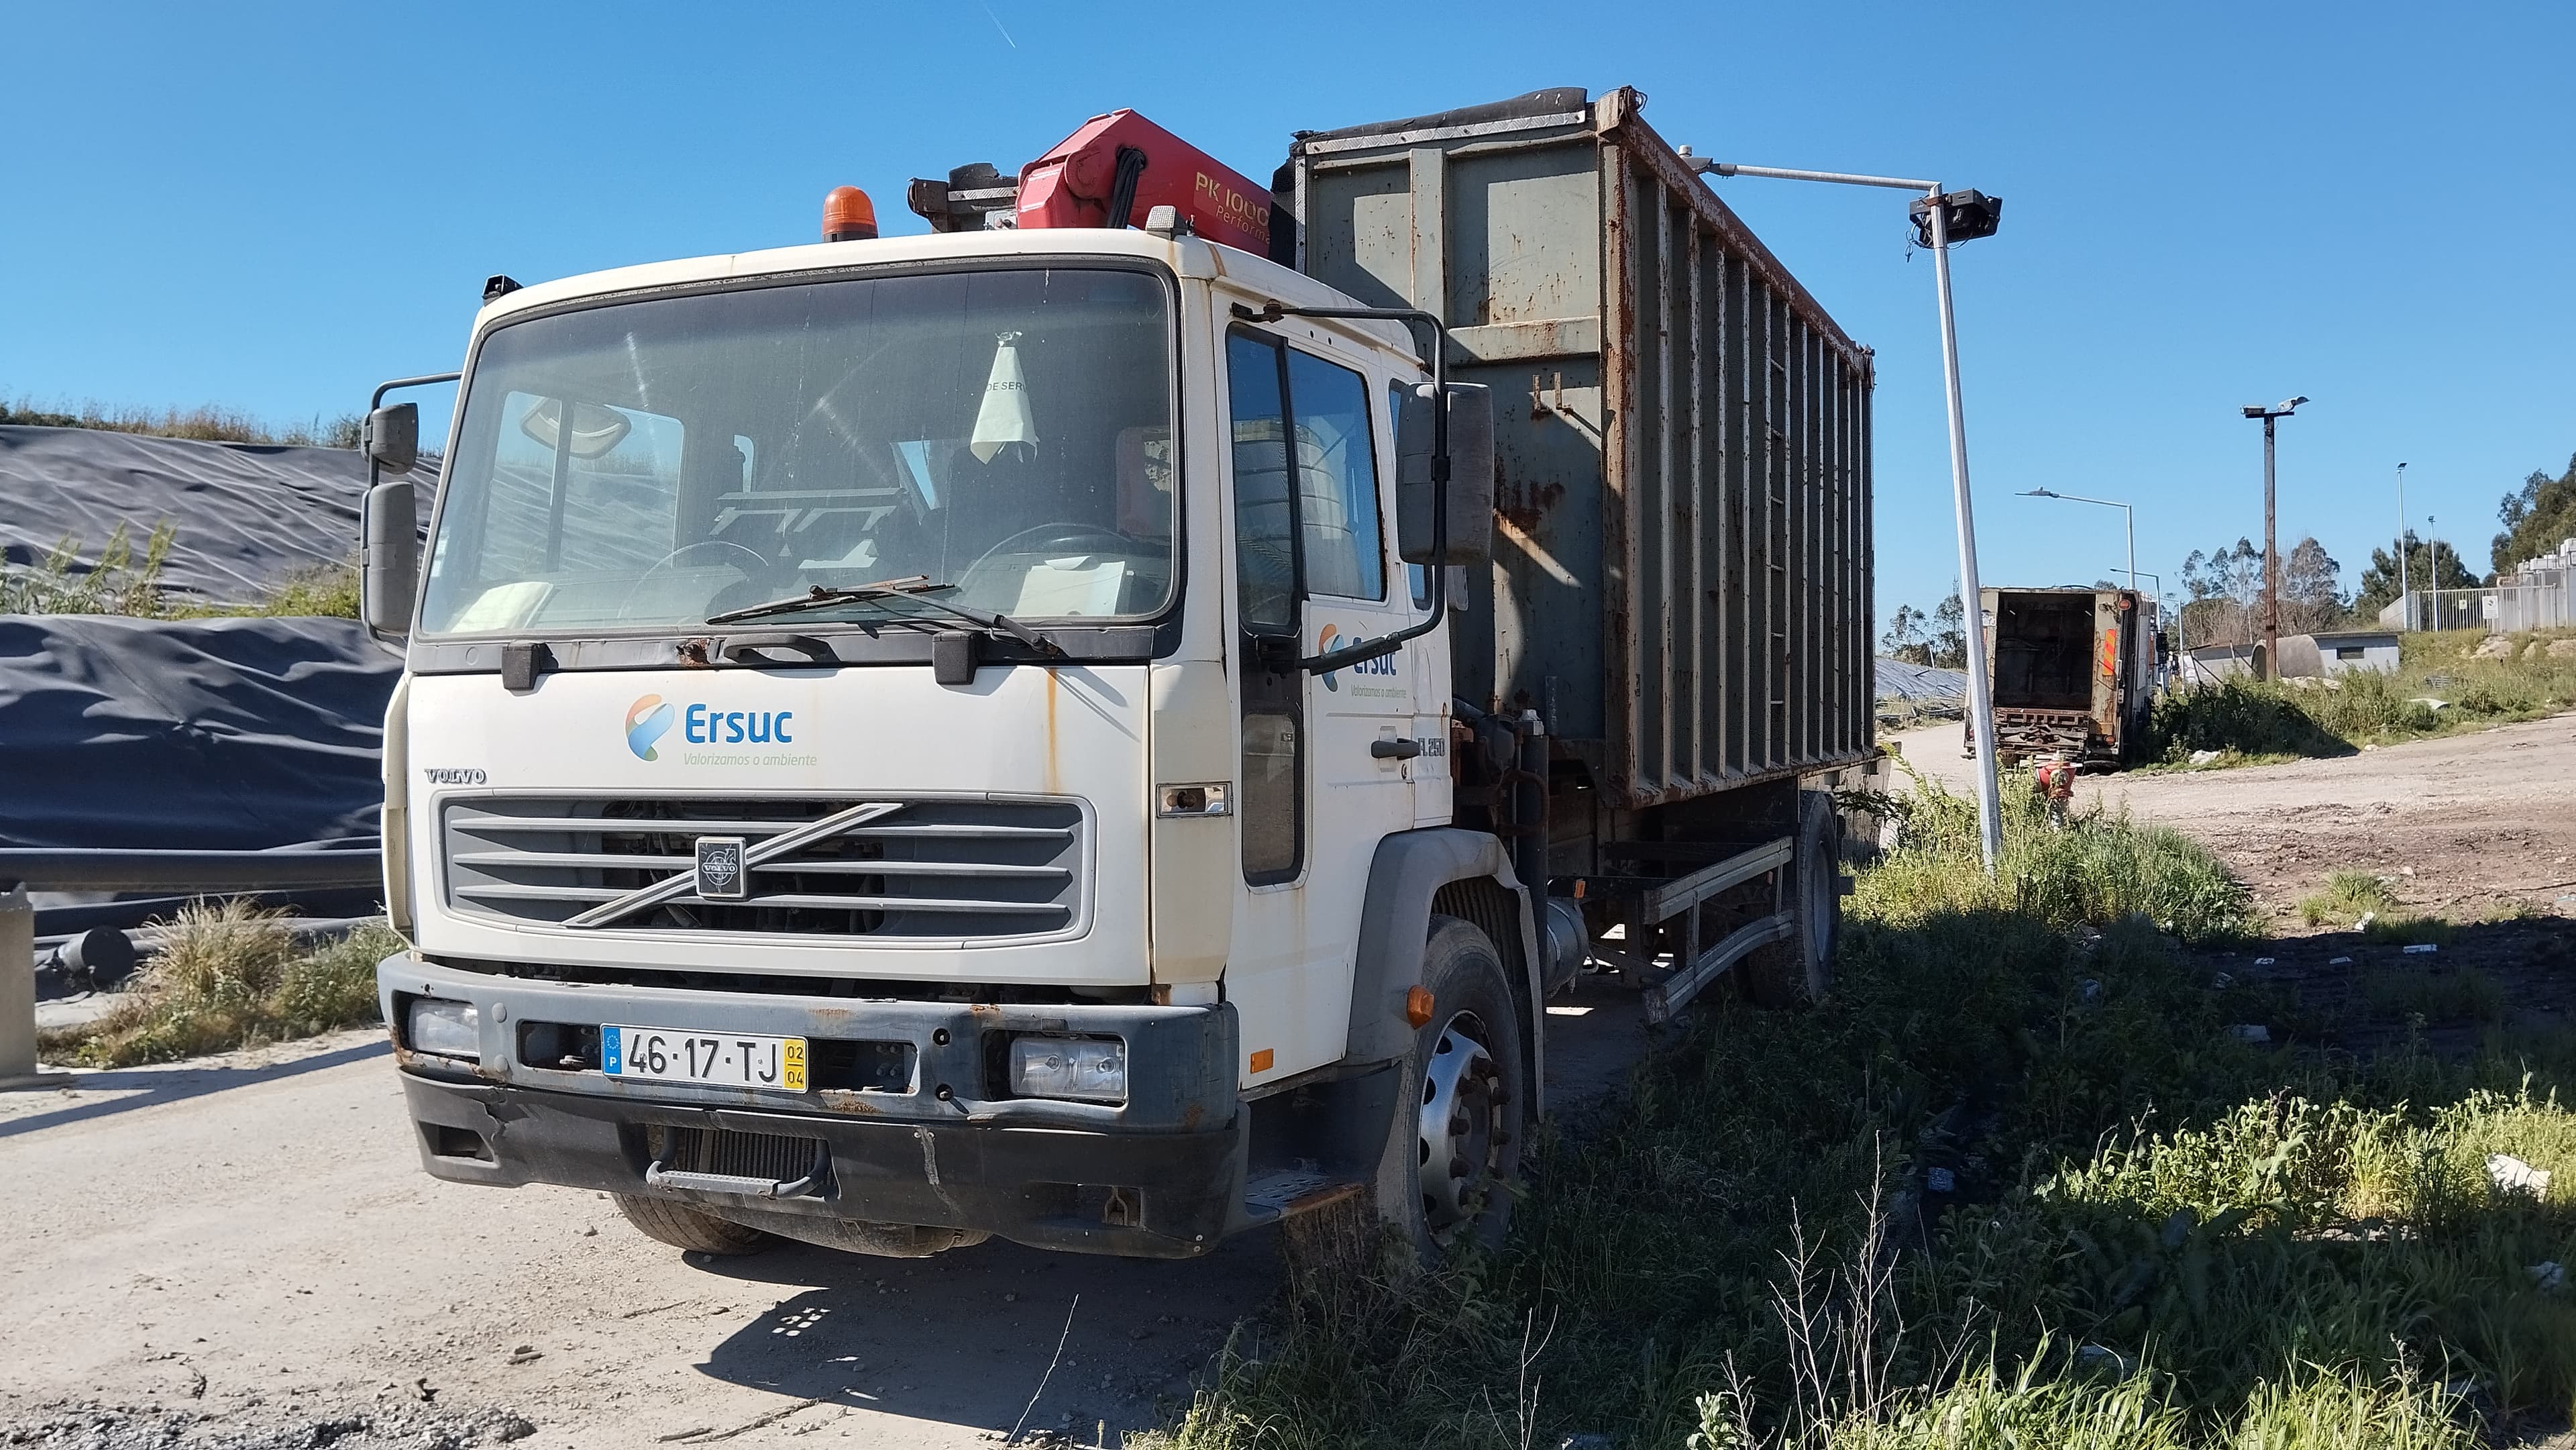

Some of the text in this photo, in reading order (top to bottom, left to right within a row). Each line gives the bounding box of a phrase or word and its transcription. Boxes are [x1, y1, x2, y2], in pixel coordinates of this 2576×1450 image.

[1195, 171, 1221, 202] PK
[686, 703, 792, 743] Ersuc
[1428, 737, 1445, 757] 250
[684, 753, 817, 766] Valorizamos o ambiente
[424, 768, 487, 784] VOLVO
[787, 1046, 804, 1059] 02
[609, 1056, 617, 1067] P
[787, 1070, 804, 1084] 04
